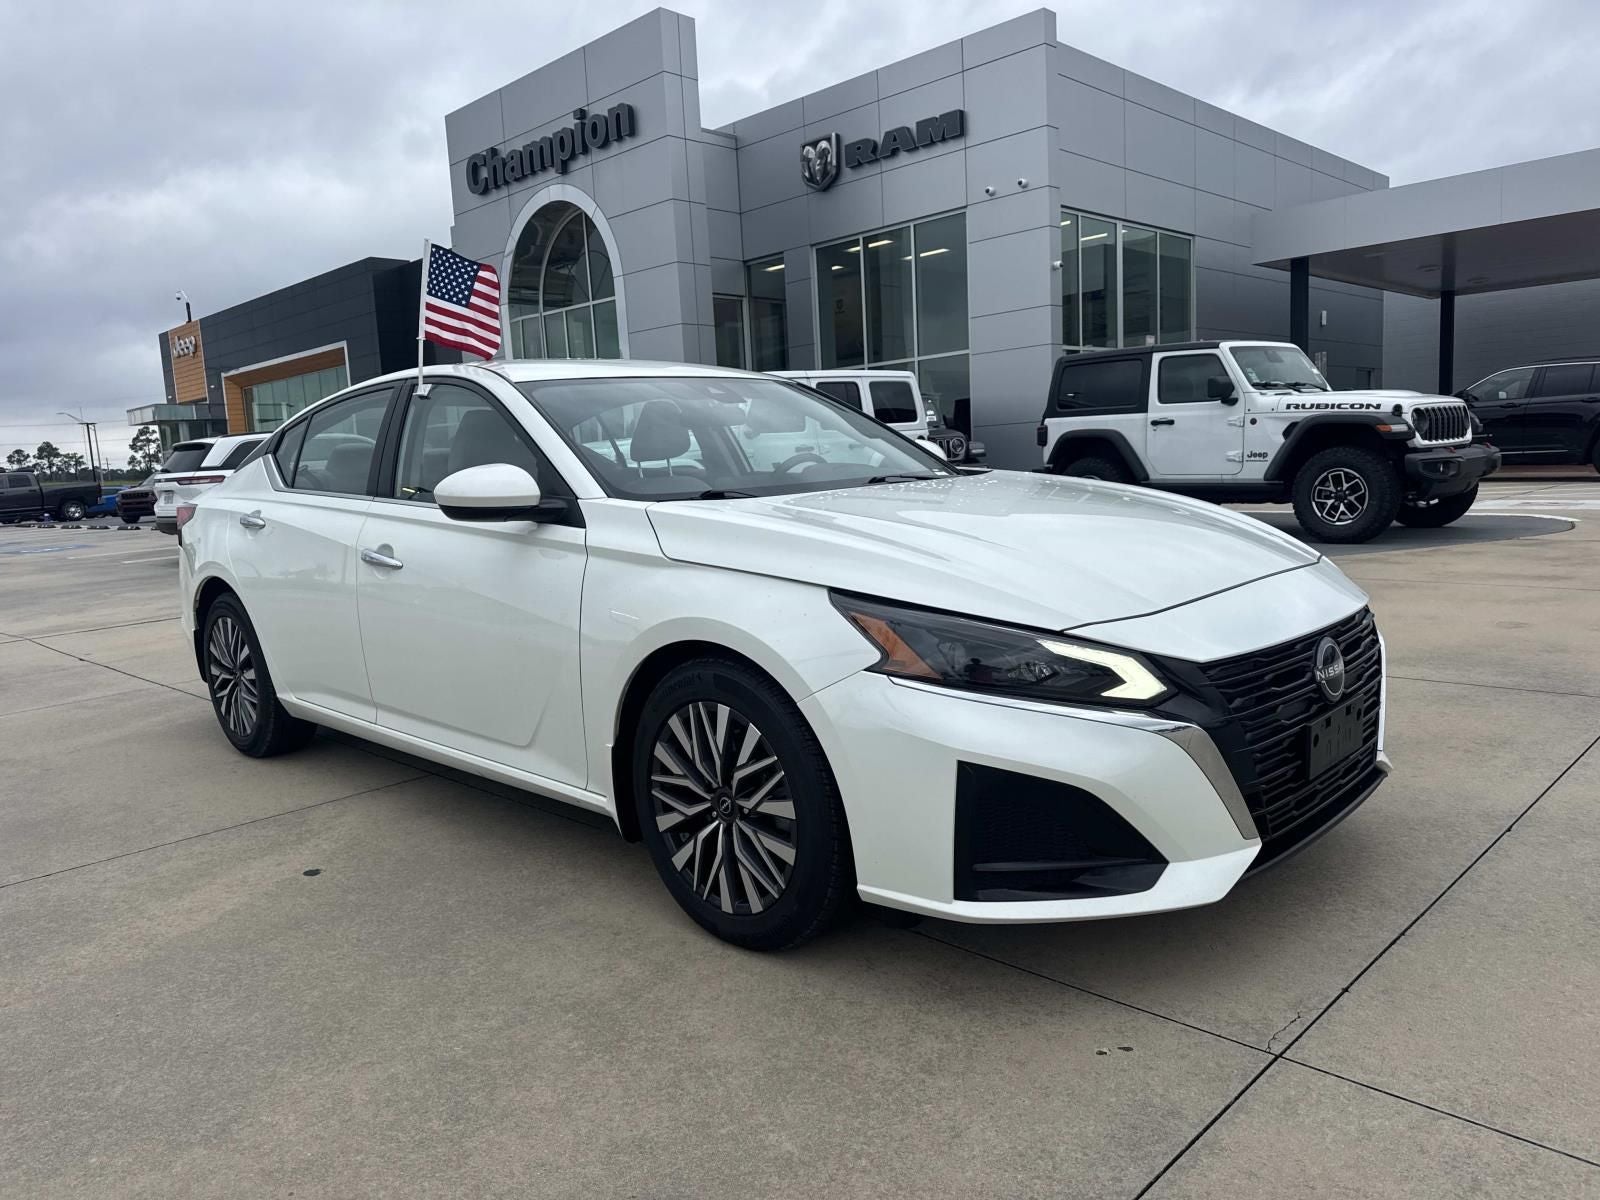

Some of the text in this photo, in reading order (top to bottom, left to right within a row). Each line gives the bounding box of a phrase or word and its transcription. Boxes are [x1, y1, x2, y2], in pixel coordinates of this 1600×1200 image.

[466, 103, 635, 194] Champion
[845, 109, 965, 168] RAM
[173, 335, 196, 358] Jeep
[1247, 450, 1268, 459] Jeep
[1316, 662, 1343, 681] NISS
